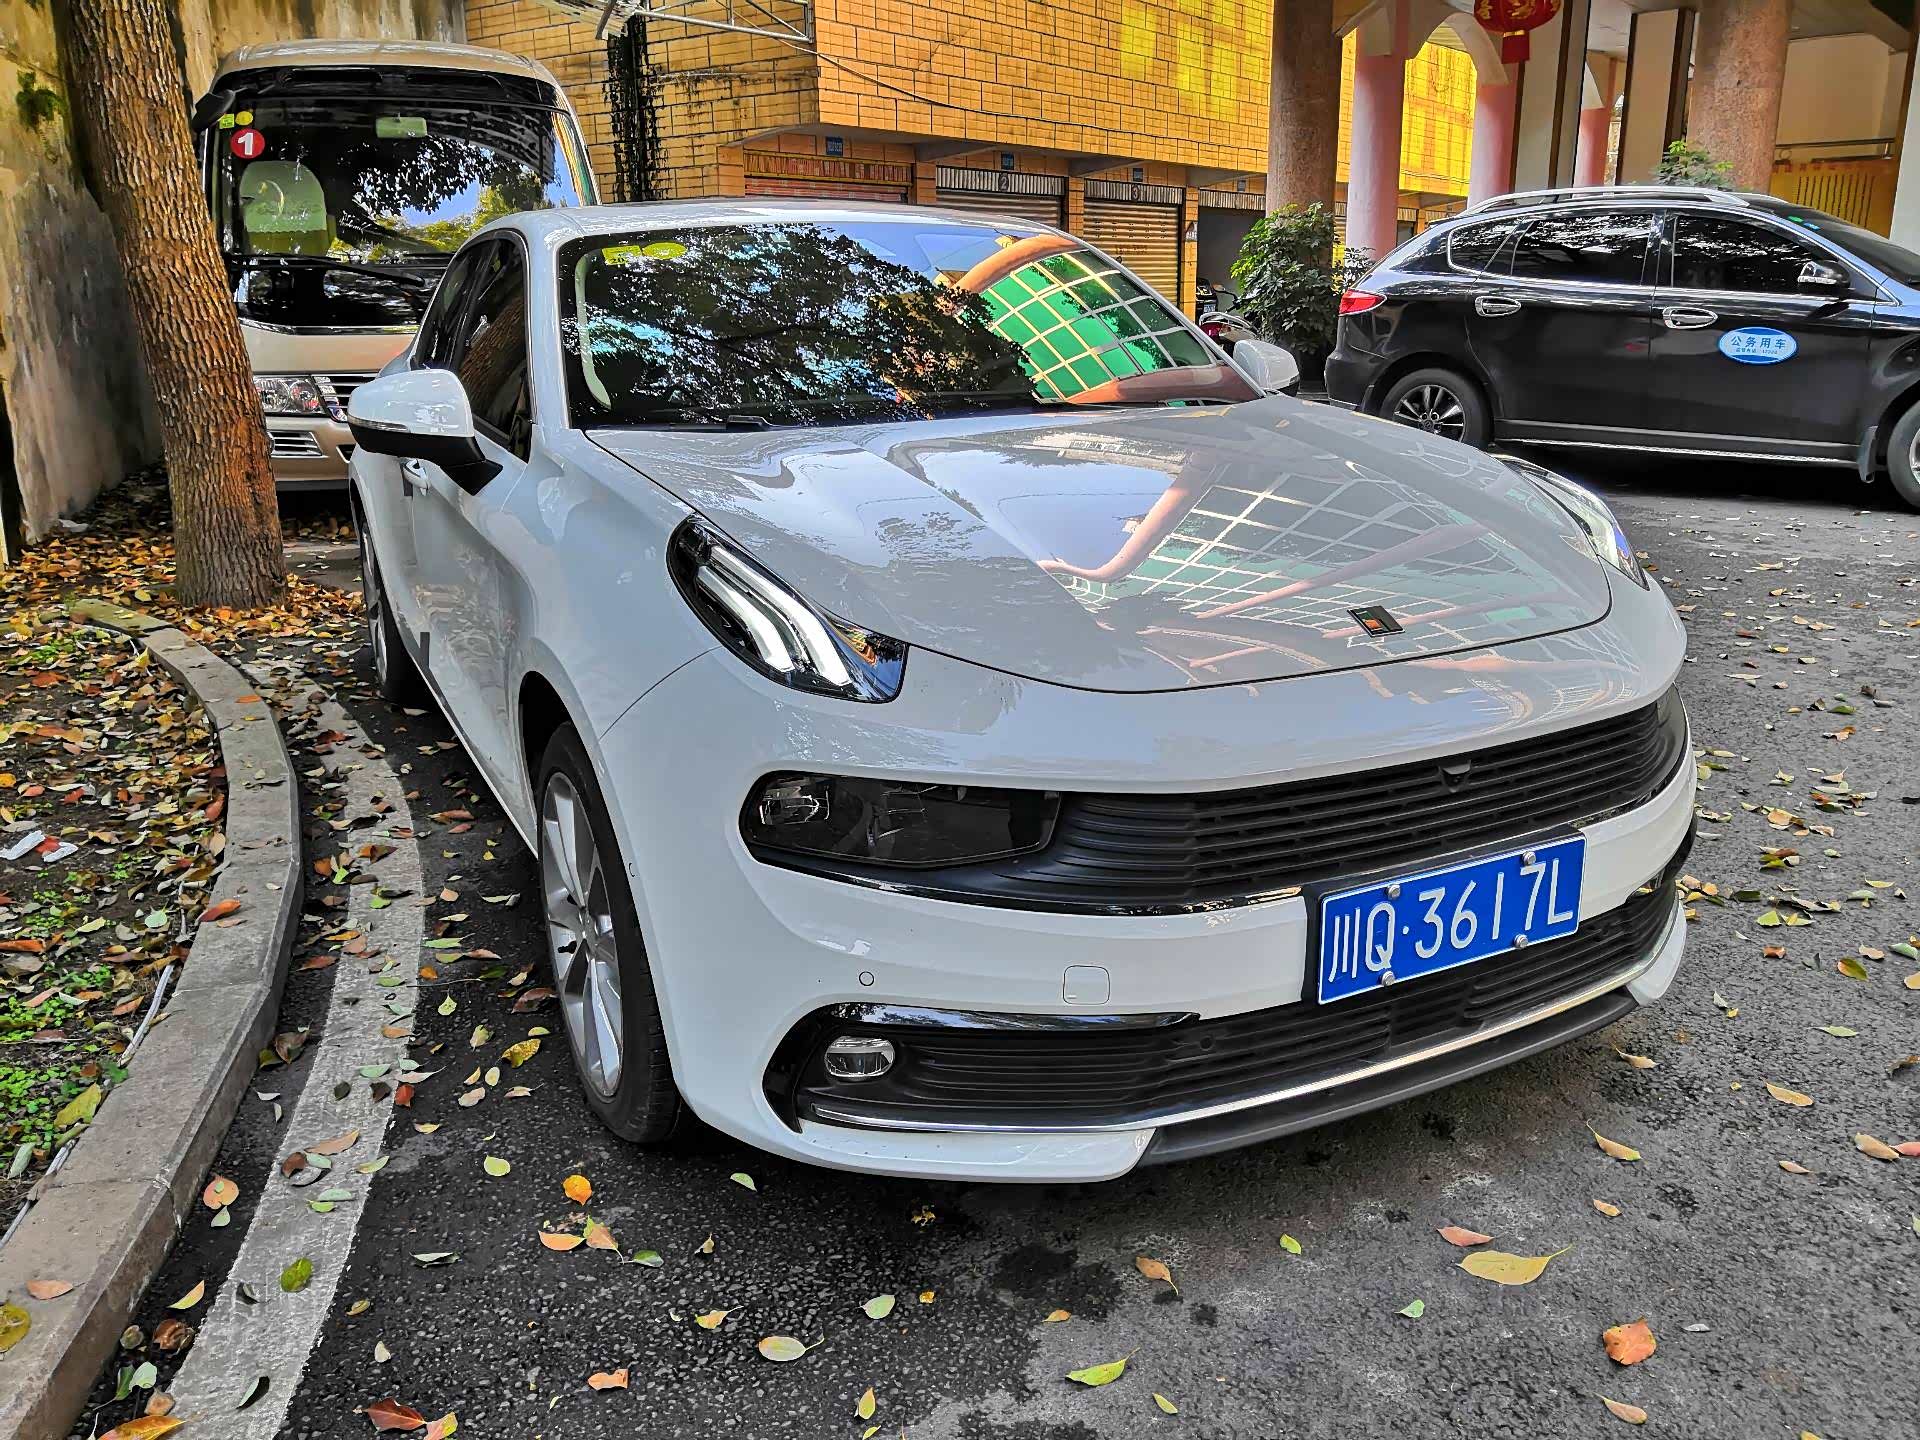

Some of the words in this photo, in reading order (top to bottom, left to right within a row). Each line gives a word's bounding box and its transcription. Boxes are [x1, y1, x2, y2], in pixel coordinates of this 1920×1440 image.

[237, 132, 254, 156] 1
[1731, 335, 1787, 350] 公务用车
